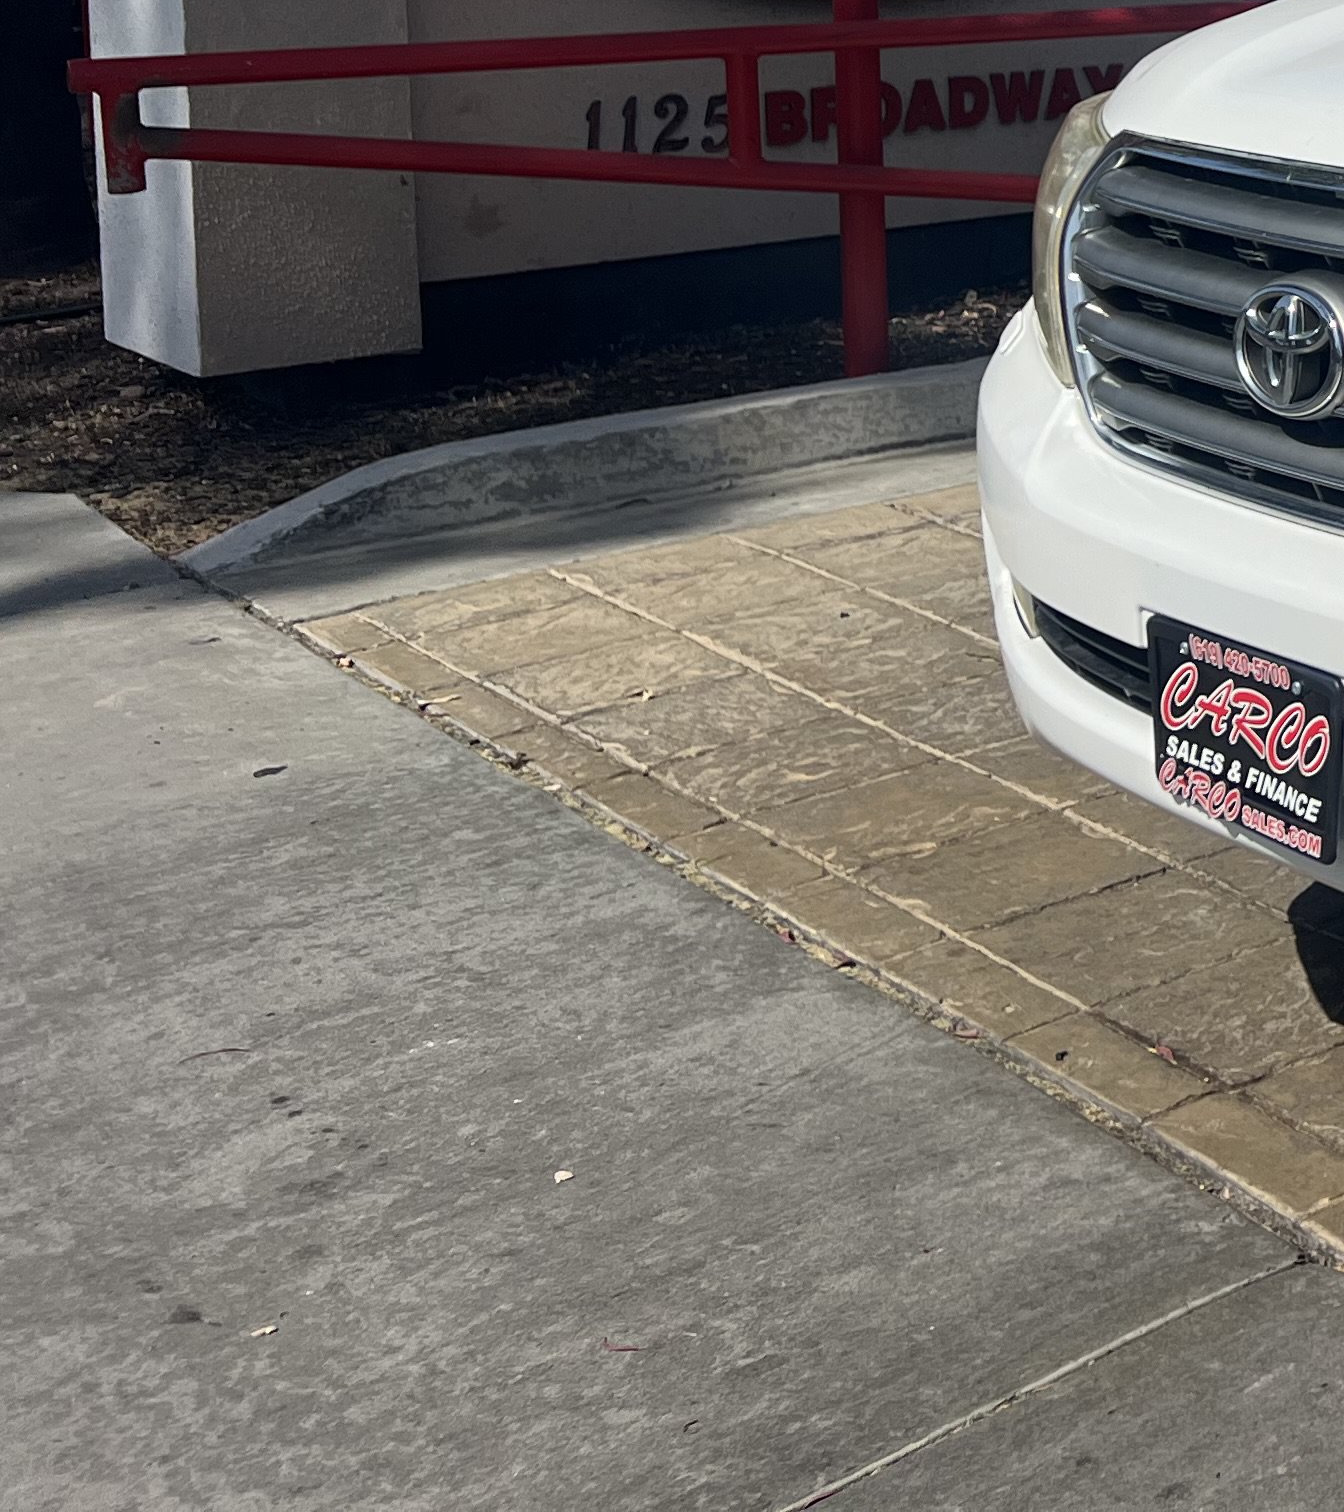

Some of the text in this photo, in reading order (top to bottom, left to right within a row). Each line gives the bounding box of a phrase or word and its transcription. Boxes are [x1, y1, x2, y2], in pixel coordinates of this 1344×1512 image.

[585, 91, 729, 154] 1125
[1160, 661, 1330, 777] CARCO
[1166, 734, 1323, 823] SALES & FINANCE
